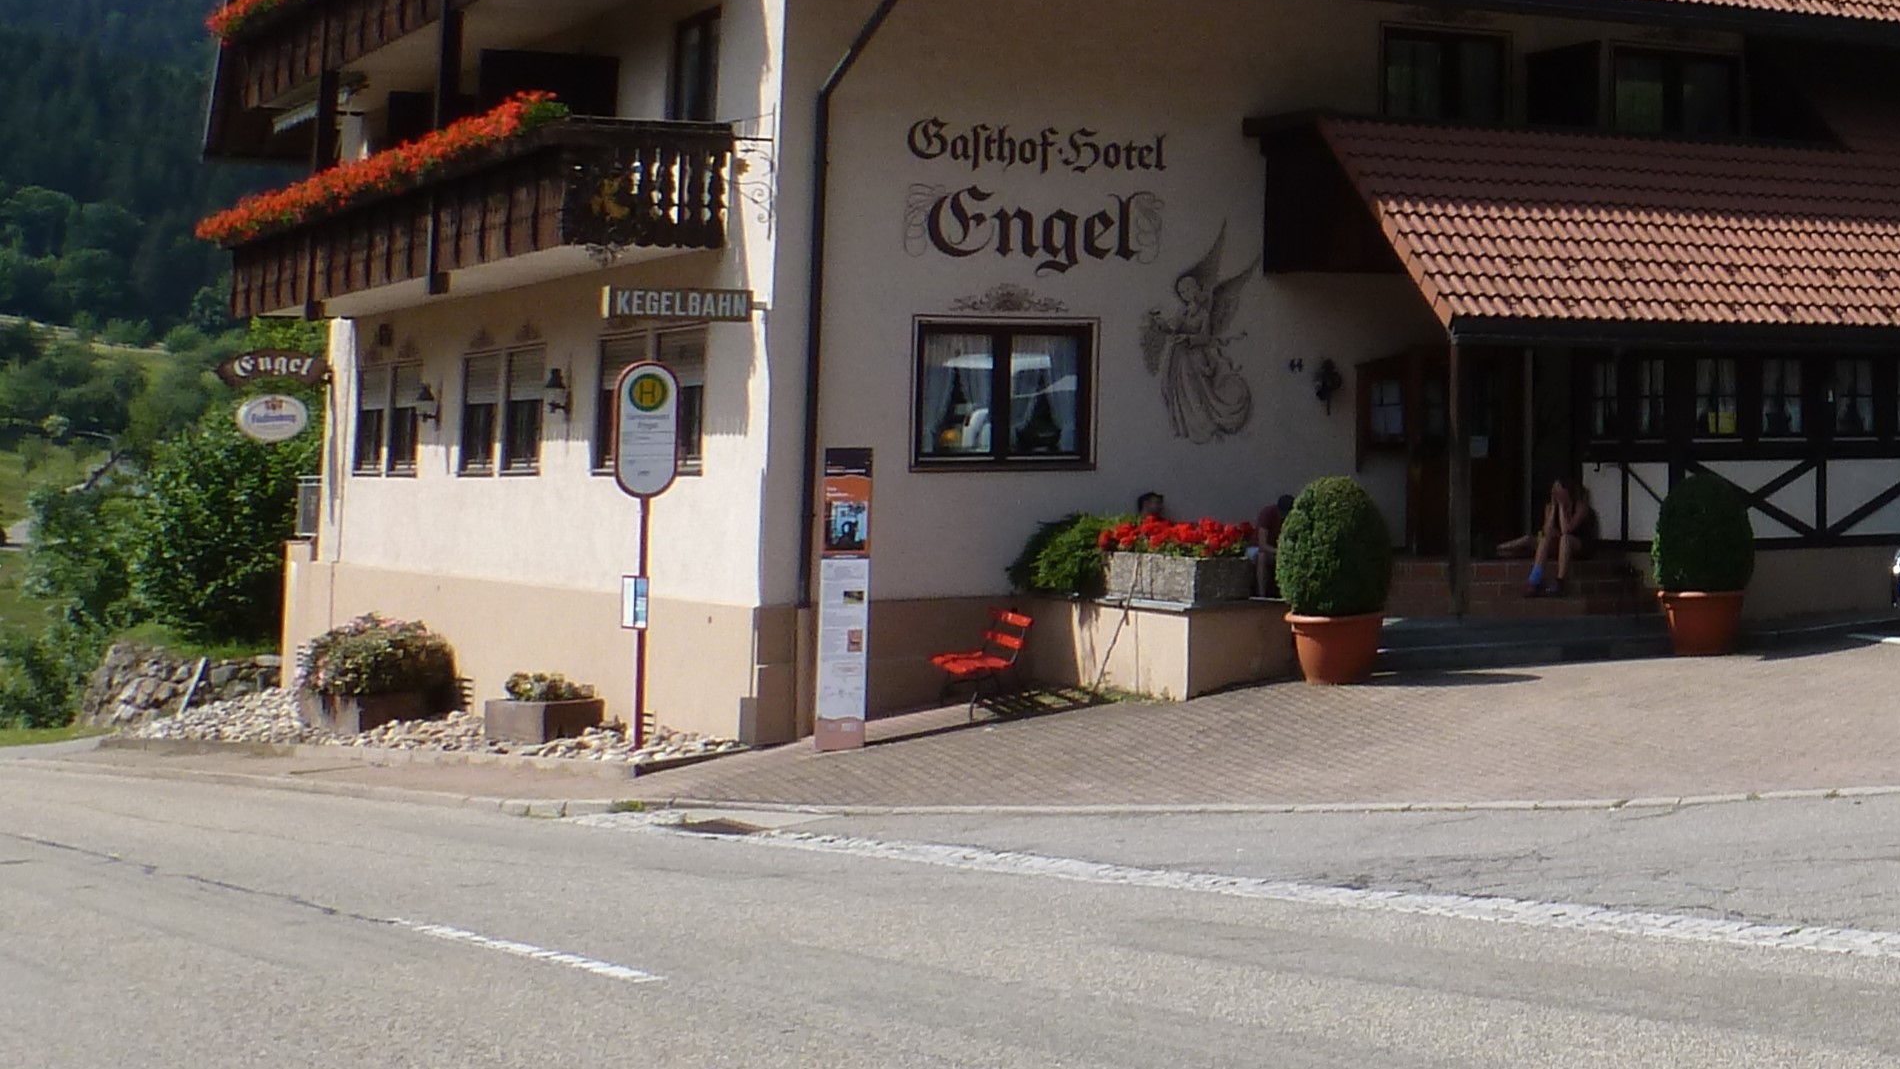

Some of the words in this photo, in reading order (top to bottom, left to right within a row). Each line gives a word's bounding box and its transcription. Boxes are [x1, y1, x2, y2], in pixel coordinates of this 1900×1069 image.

[927, 185, 1142, 277] Engel
[616, 290, 748, 317] KEGELBAHN
[233, 355, 315, 376] Engel
[640, 382, 656, 403] H
